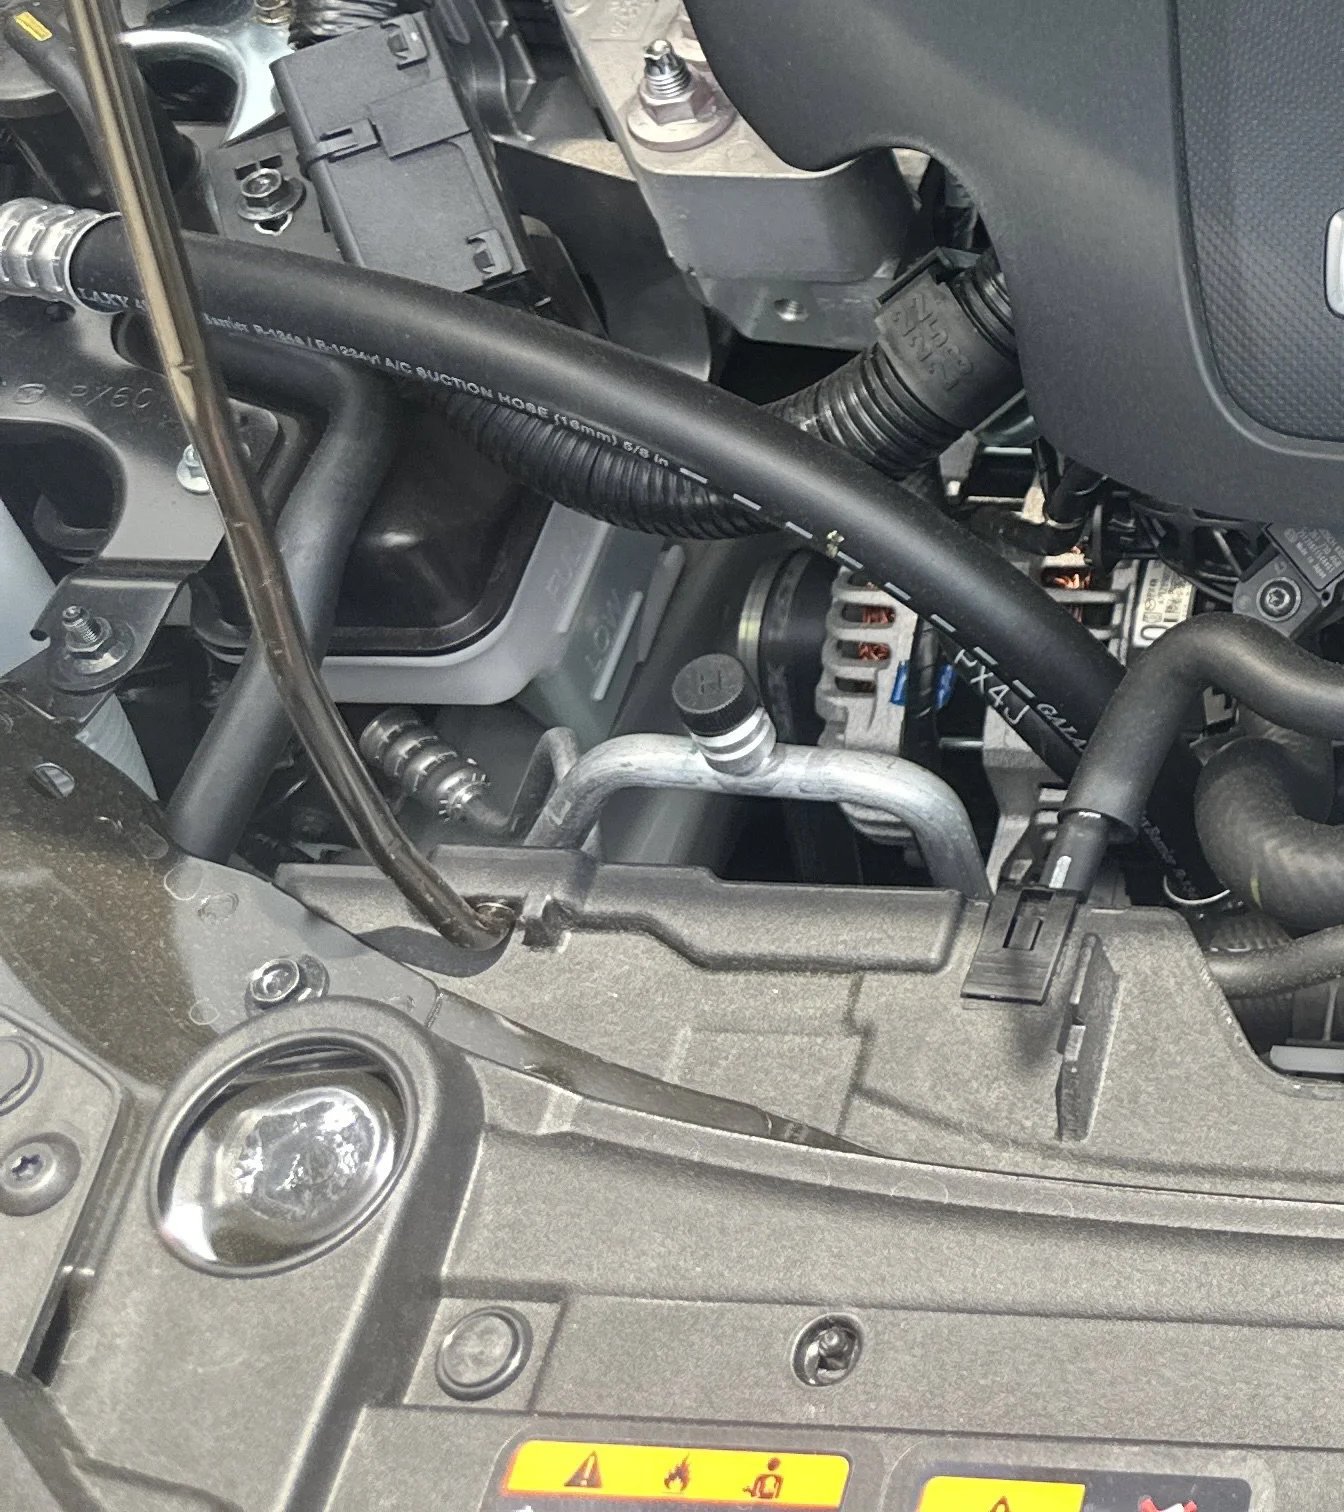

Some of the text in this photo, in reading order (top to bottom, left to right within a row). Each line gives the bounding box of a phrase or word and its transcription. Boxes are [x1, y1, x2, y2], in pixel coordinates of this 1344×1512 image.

[77, 287, 129, 308] LAXY
[385, 356, 412, 375] A/C
[415, 366, 493, 399] SUCTION
[498, 391, 550, 419] HOSE
[653, 453, 670, 467] in
[954, 649, 1031, 726] PX4J
[1036, 702, 1088, 753] GALA
